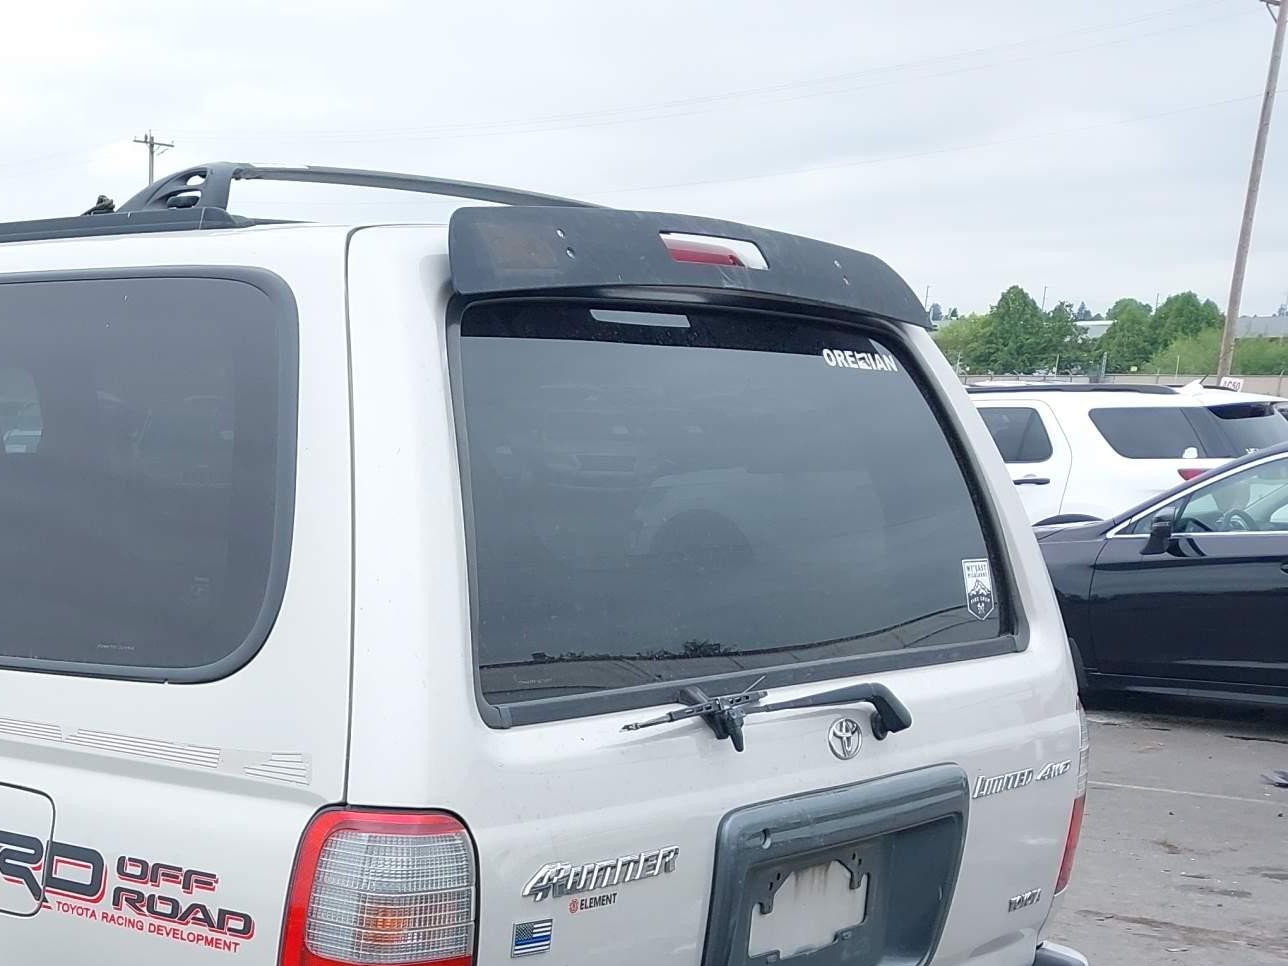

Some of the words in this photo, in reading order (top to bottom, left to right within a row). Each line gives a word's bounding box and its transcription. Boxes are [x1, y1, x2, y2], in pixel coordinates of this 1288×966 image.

[971, 768, 1035, 800] LIMITED
[116, 854, 220, 894] OFF
[112, 885, 255, 940] ROAD
[579, 892, 618, 911] ELEMENT
[55, 900, 98, 921] TOYOTA
[101, 908, 144, 931] RACING
[147, 923, 241, 954] DEVELOPMENT
